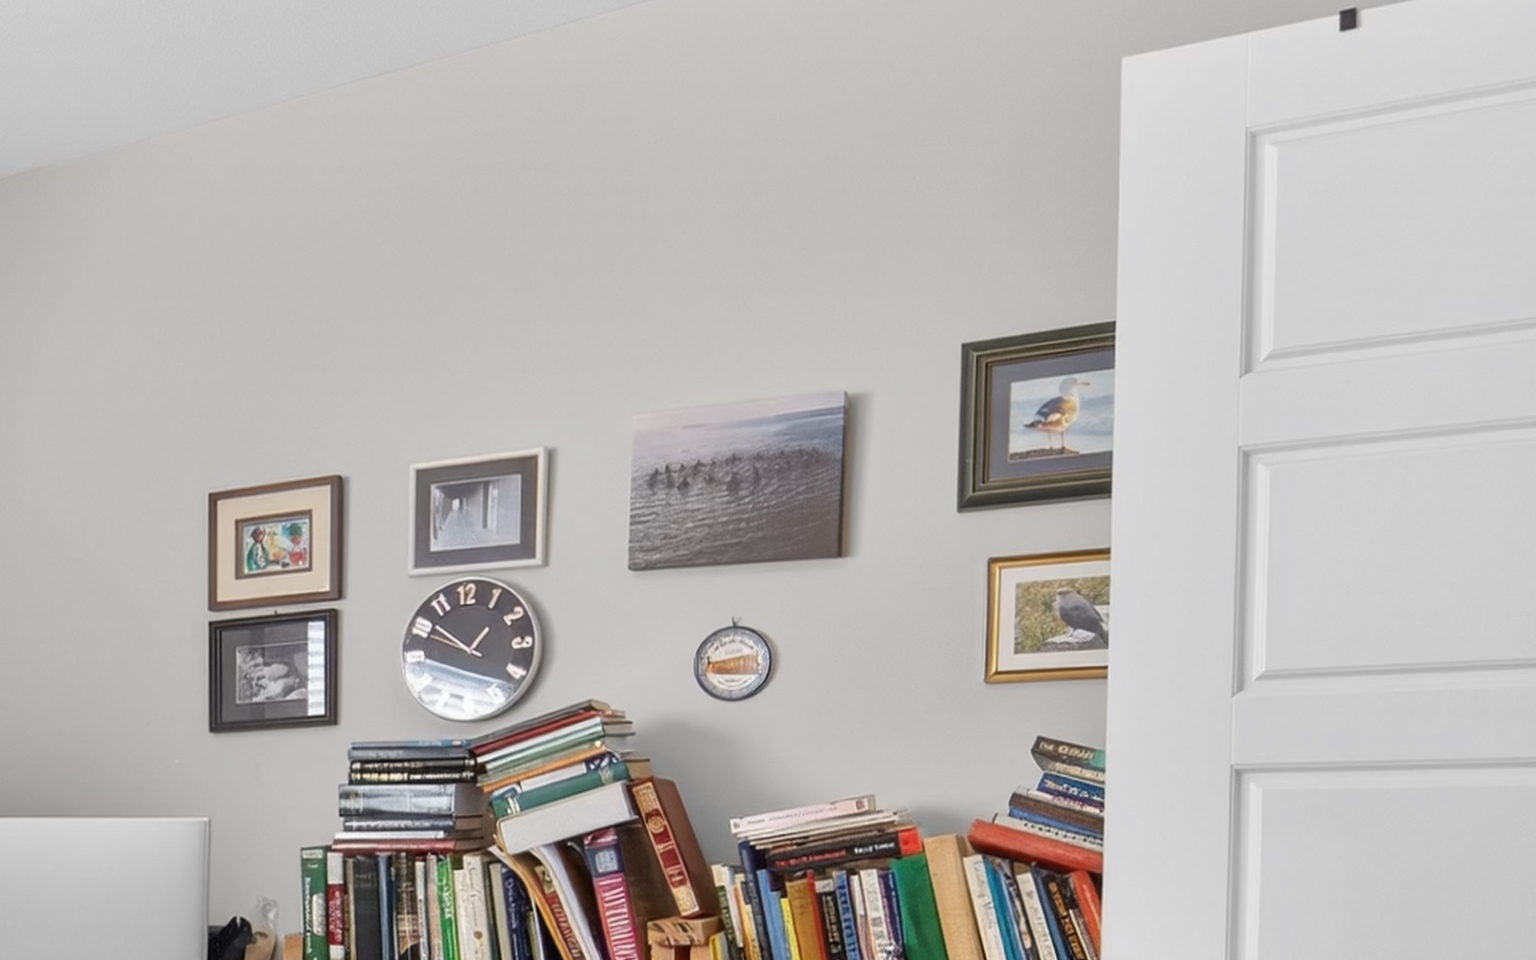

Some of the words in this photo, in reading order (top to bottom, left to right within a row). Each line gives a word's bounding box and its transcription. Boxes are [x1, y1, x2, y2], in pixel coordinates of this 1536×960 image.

[431, 593, 451, 616] 11
[456, 583, 476, 605] 12
[488, 588, 502, 609] 1
[503, 606, 524, 626] 2
[412, 617, 433, 638] 10
[511, 636, 533, 649] 3
